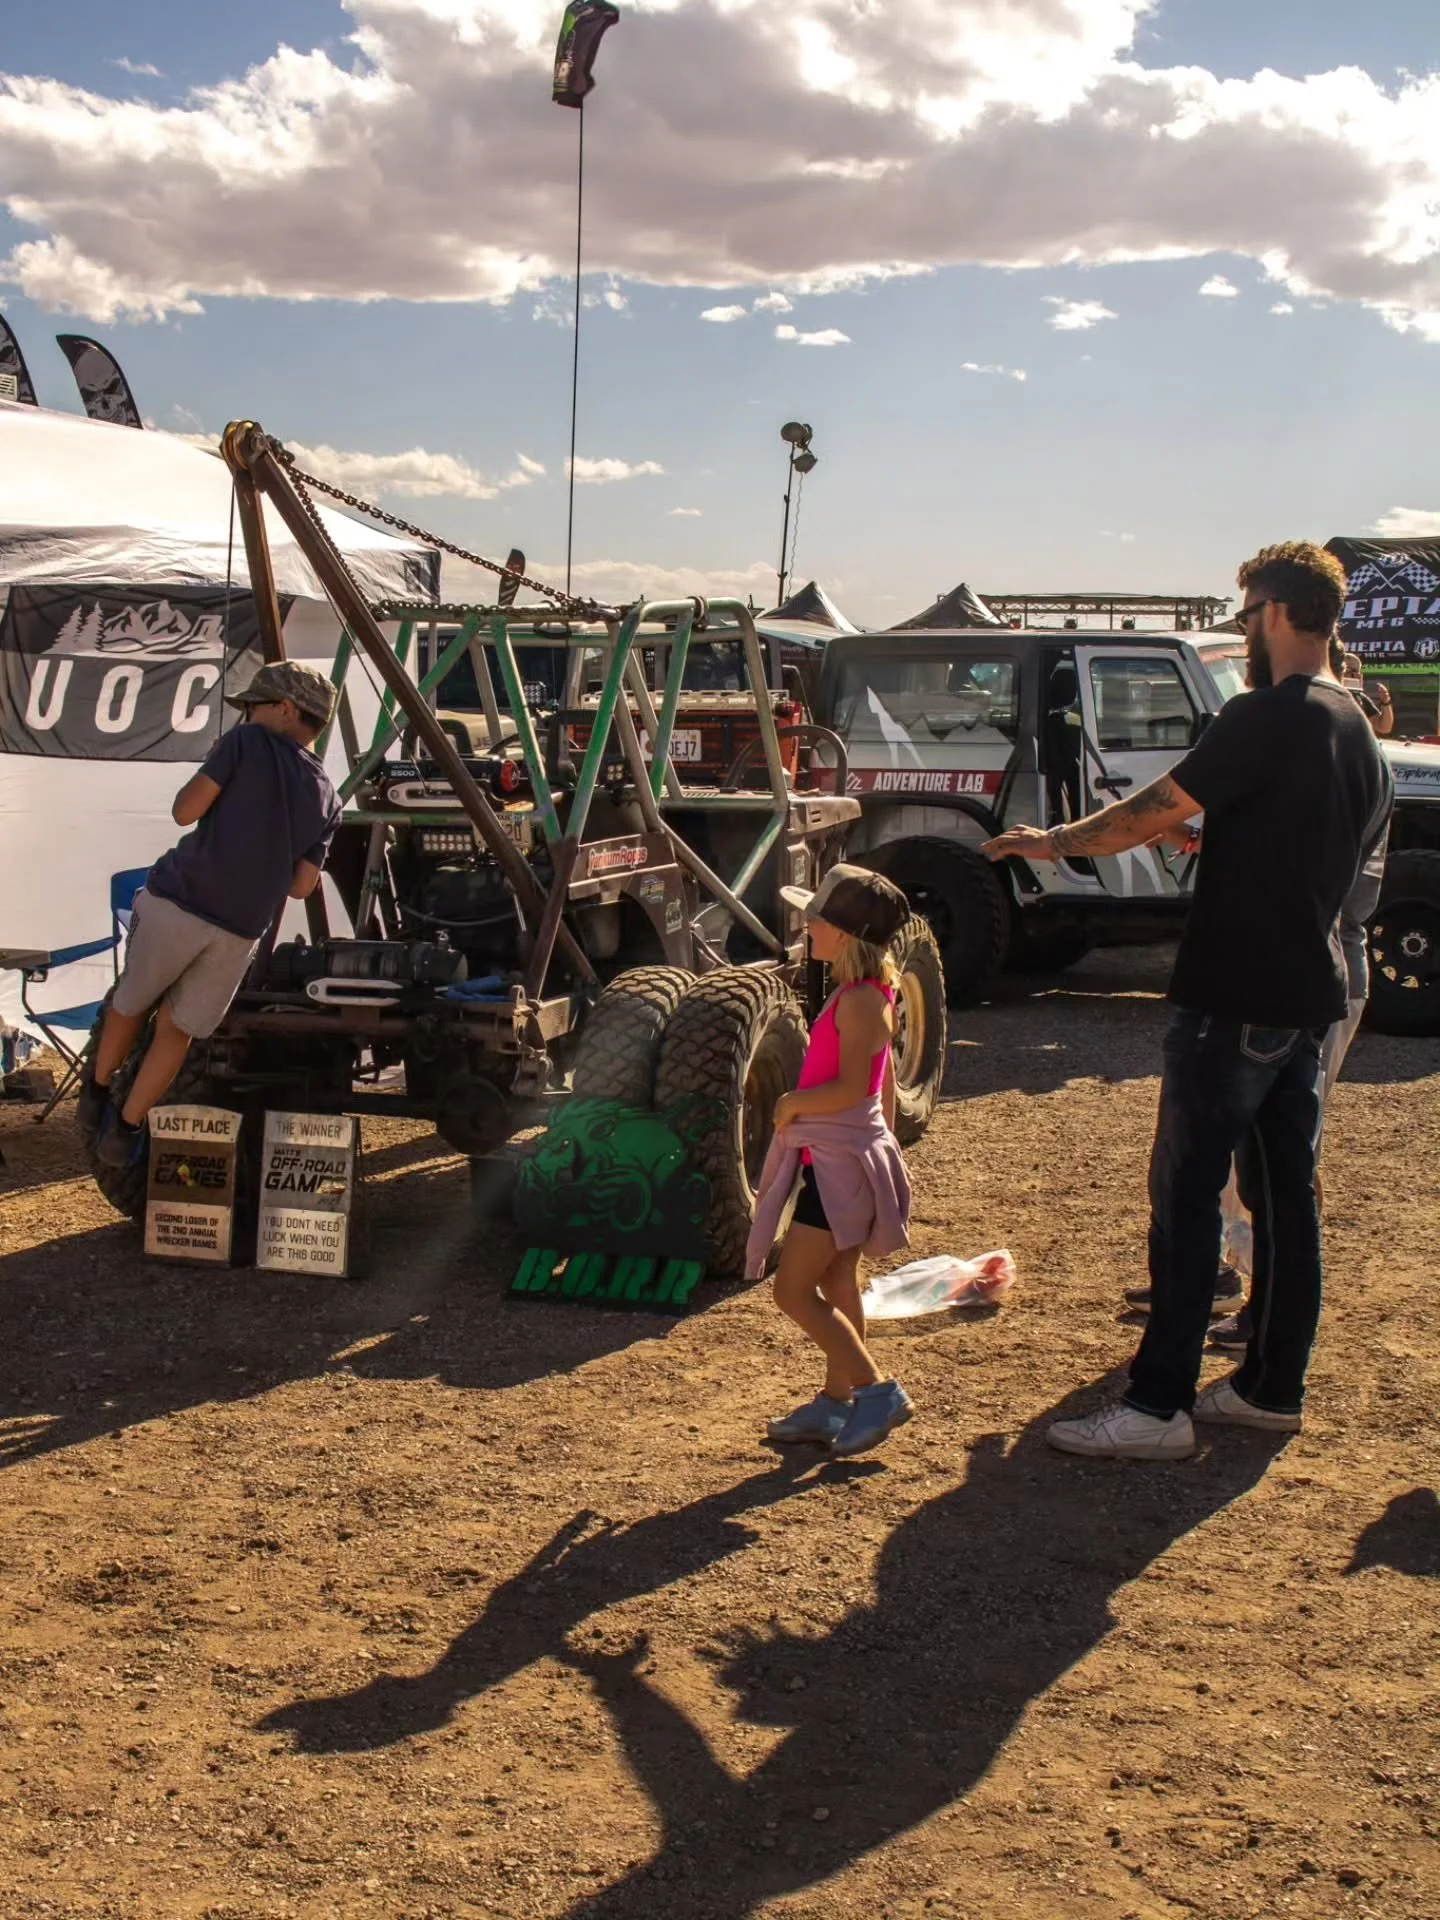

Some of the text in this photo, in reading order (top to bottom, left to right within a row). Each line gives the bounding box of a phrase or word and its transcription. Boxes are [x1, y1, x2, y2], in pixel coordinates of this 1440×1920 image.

[1341, 596, 1440, 619] EPTA
[1356, 617, 1404, 629] MFG
[1345, 640, 1406, 653] HEPTA
[872, 771, 985, 793] ADVENTURE LAB
[157, 1117, 231, 1135] LAST PLACE
[275, 1120, 341, 1138] THE WINNER
[155, 1213, 183, 1224] SECOND
[209, 1217, 220, 1227] OF
[264, 1216, 282, 1228] YOU
[314, 1219, 340, 1232] NEED
[157, 1224, 218, 1238] THE 2ND ANNUAL
[263, 1230, 340, 1248] LUCK WHEN YOU
[156, 1236, 190, 1246] WRECKER
[266, 1246, 336, 1263] ARE THIS GOOD
